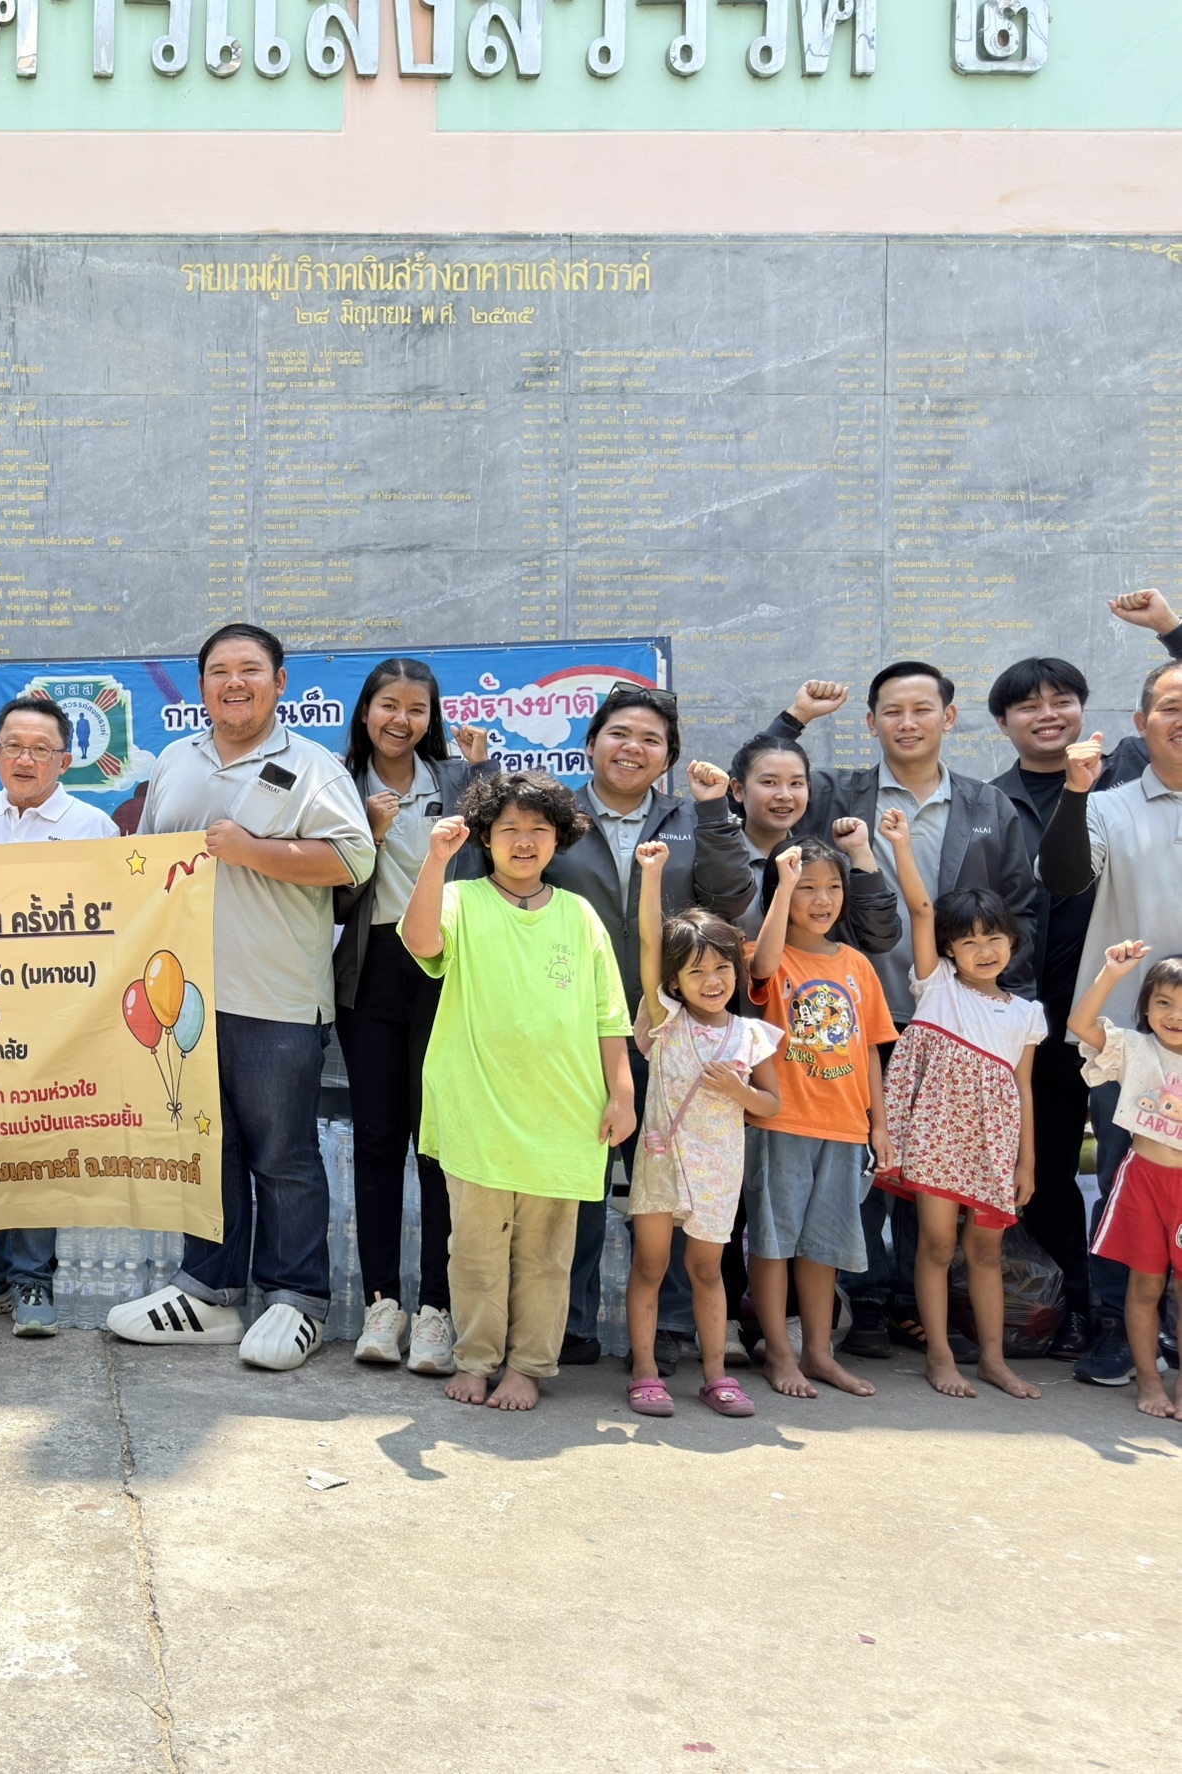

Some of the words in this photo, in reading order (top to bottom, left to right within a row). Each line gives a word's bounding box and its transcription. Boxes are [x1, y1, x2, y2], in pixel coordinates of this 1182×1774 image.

[180, 253, 651, 302] รายนามผู้บริจาคเงินสร้างอาคารแสงสวรรค์
[295, 306, 331, 325] ๒๘
[340, 299, 412, 332] มิถุนายน
[443, 676, 595, 722] รสร้างชาติ
[659, 832, 692, 841] SUPALAI
[11, 892, 77, 933] ครั้งที่
[21, 960, 97, 989] (มหาชน)
[9, 1078, 98, 1105] ความห่วงใย
[84, 1152, 202, 1186] จ.นครสวรรค์
